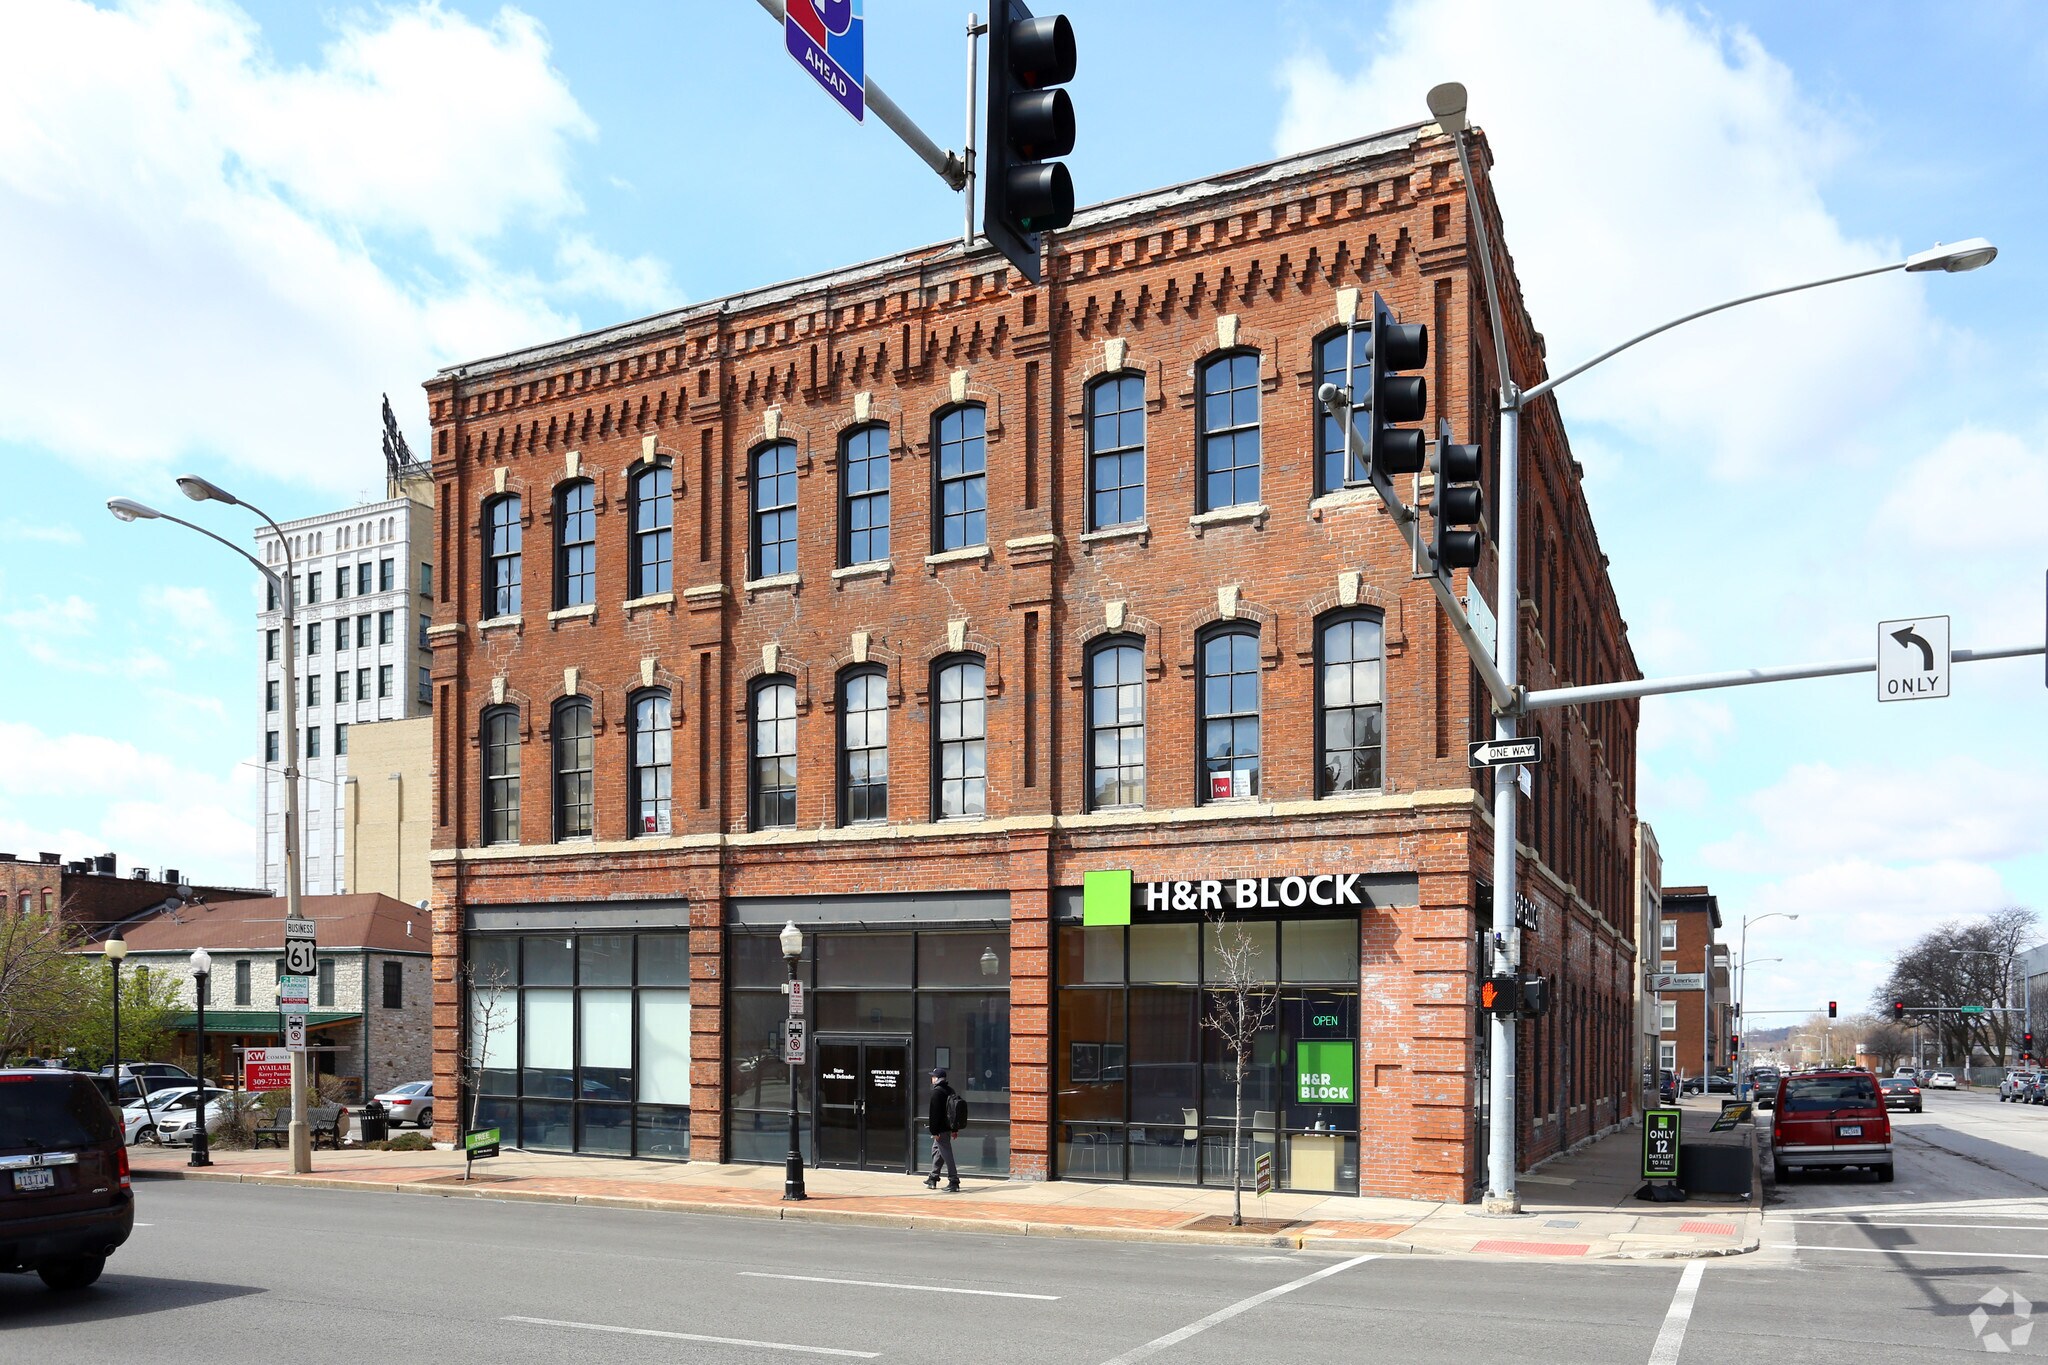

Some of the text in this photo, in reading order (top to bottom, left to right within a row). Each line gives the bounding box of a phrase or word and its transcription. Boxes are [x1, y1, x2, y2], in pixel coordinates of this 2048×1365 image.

[805, 47, 847, 97] AHEAD
[1888, 676, 1939, 694] ONLY
[1490, 746, 1532, 758] ONE WAY
[1147, 873, 1362, 911] H&R BLOCK
[288, 923, 314, 934] BUSINESS
[291, 947, 310, 968] 61
[1313, 1016, 1338, 1026] OPEN
[247, 1052, 265, 1061] KW
[253, 1078, 291, 1086] 309-721-32
[1301, 1073, 1331, 1085] H&R
[1301, 1087, 1349, 1098] BLOCK
[474, 1131, 490, 1142] FREE
[1650, 1130, 1675, 1139] ONLY
[1655, 1140, 1668, 1153] 12
[18, 1175, 32, 1186] 113
